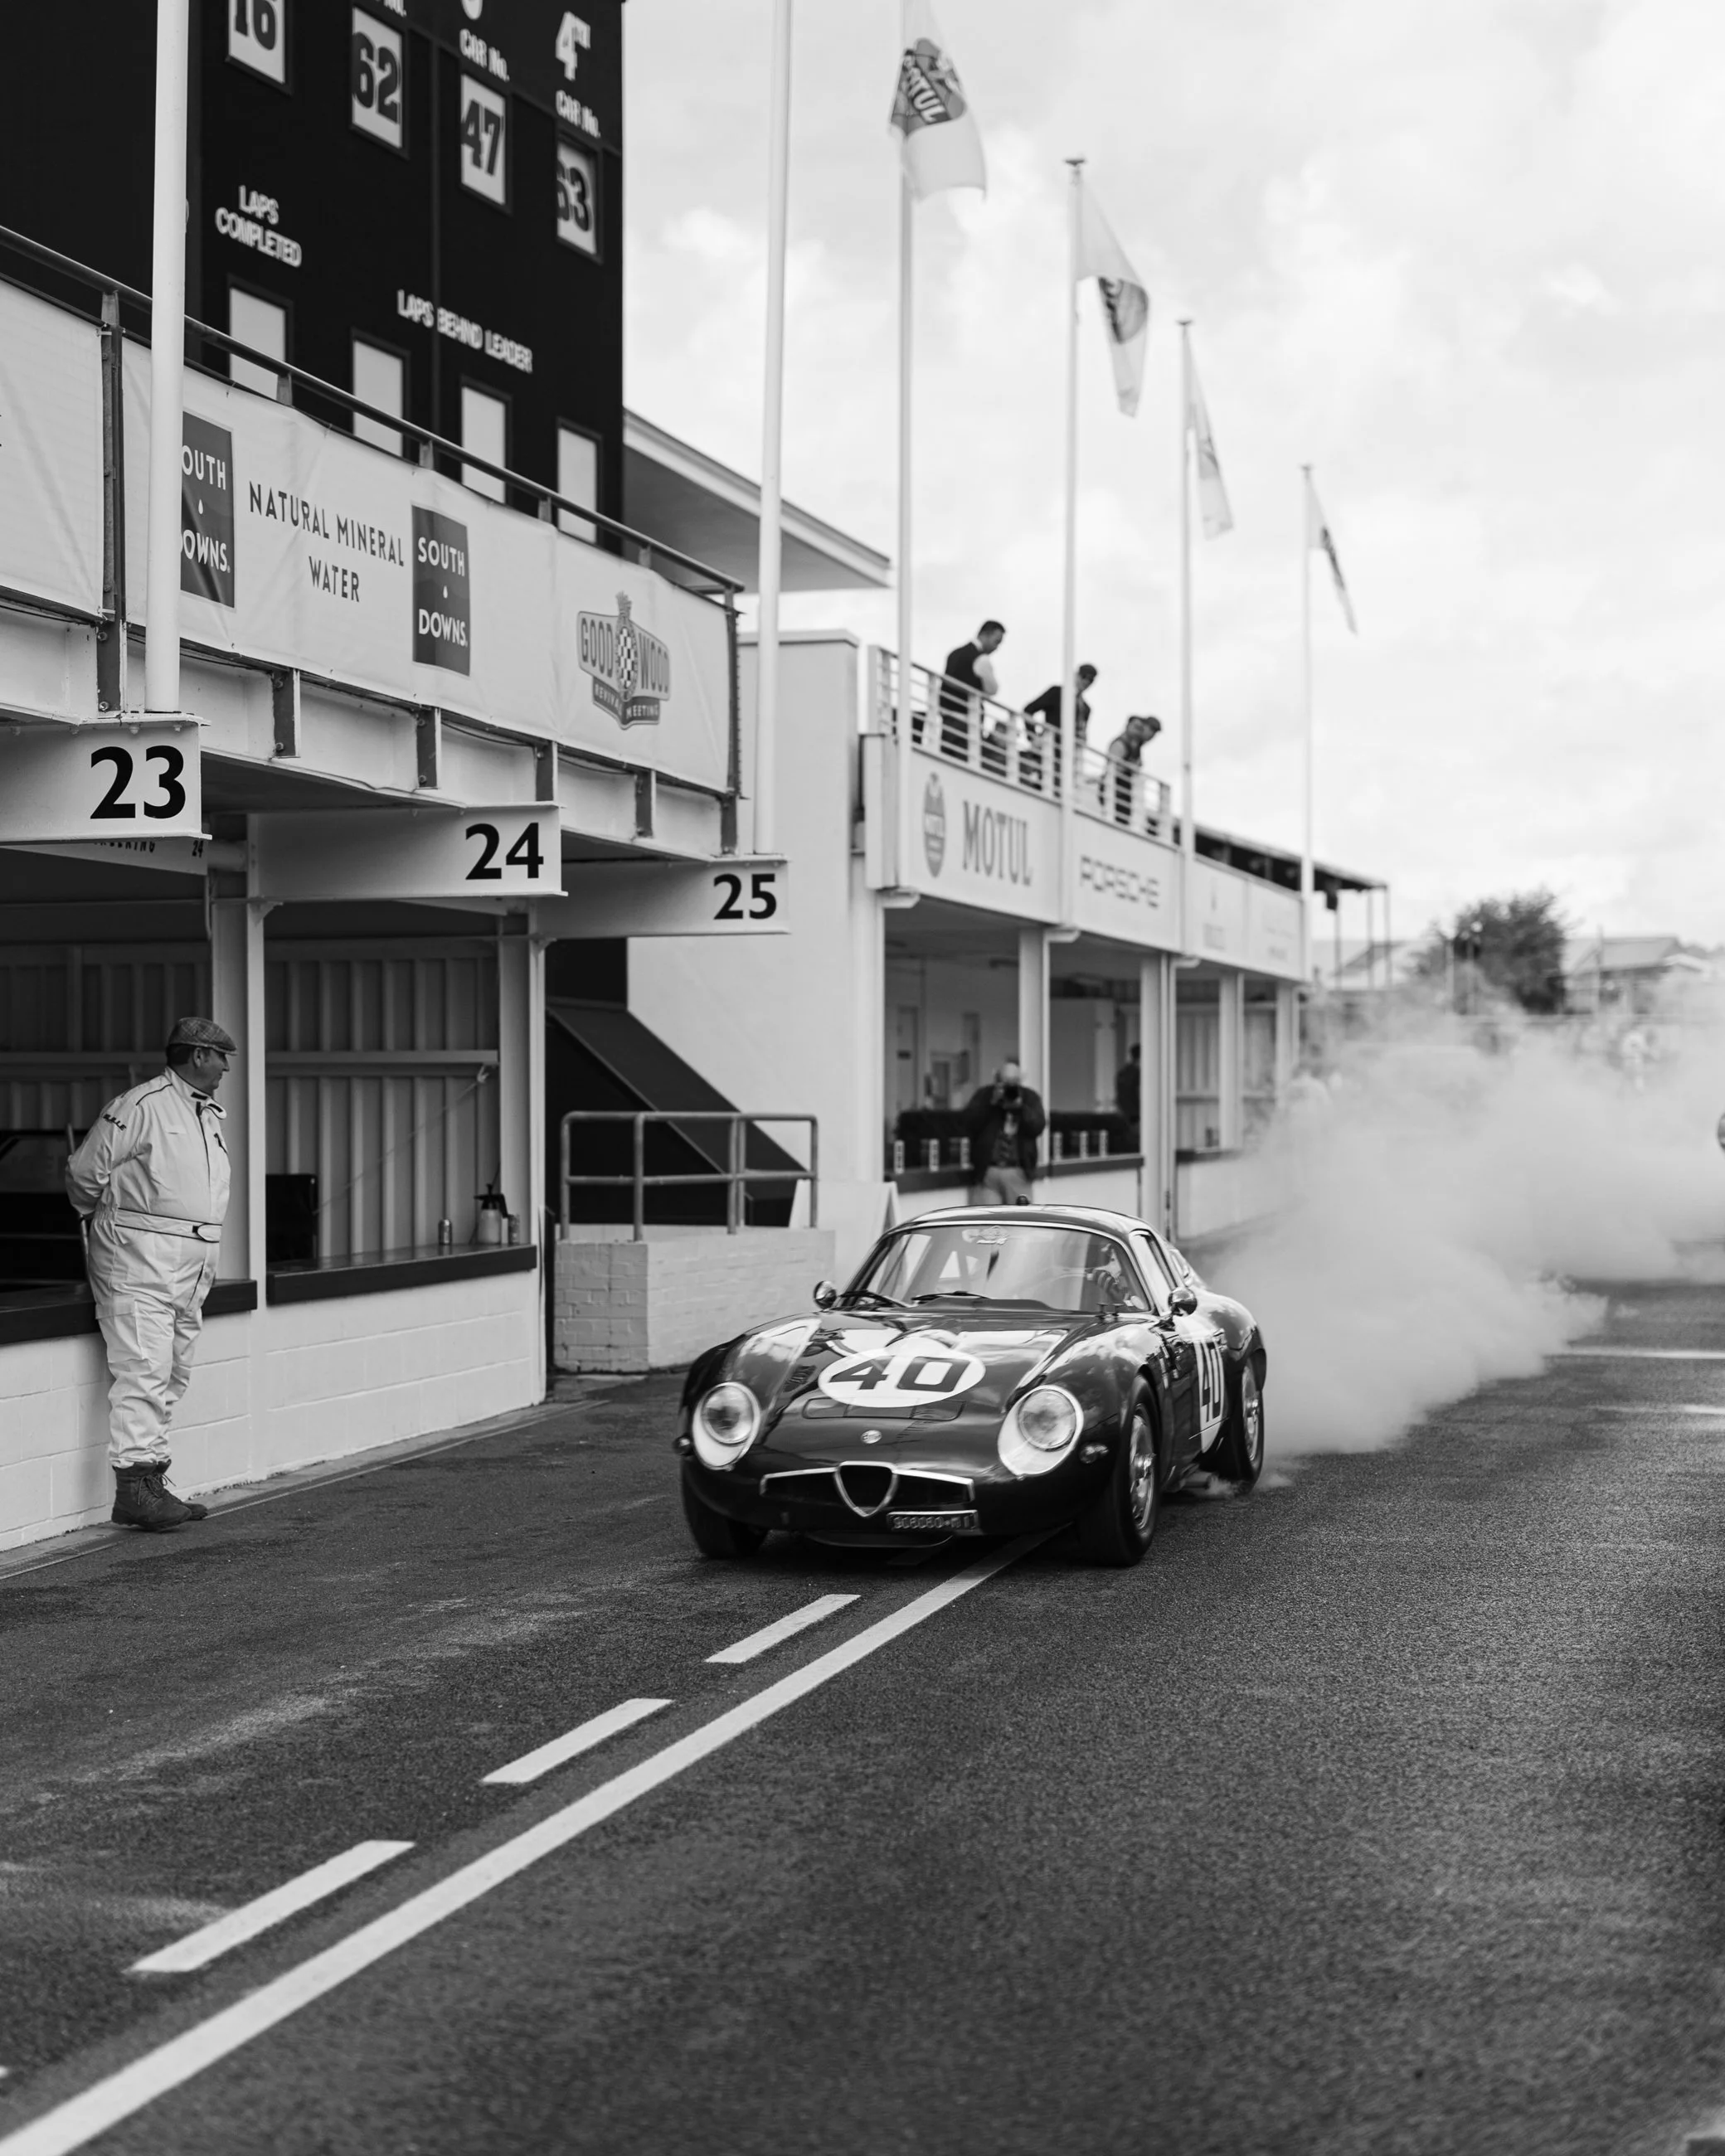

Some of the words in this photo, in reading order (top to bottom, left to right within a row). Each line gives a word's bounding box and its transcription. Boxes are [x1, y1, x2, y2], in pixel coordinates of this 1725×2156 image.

[459, 28, 488, 68] CAR
[352, 32, 401, 124] 62
[556, 90, 581, 126] CAR
[461, 98, 504, 177] 47
[238, 184, 279, 226] LAPS
[215, 206, 303, 268] COMPLETED
[396, 289, 435, 328] LAPS
[436, 306, 483, 350] BEHIND
[483, 329, 533, 374] LEADER
[181, 444, 226, 490] OUTH
[249, 481, 330, 540] NATURAL
[336, 513, 405, 567] MINERAL
[309, 556, 359, 602] WATER
[418, 537, 465, 577] SOUTH
[581, 617, 614, 678] GOOD
[89, 745, 186, 820] 23
[192, 840, 204, 858] 24
[464, 822, 544, 881] 24
[962, 799, 1033, 886] MOTUL
[713, 872, 778, 920] 25
[1080, 853, 1159, 910] PORSCHE
[828, 1355, 972, 1393] 40
[1201, 1340, 1222, 1423] 40
